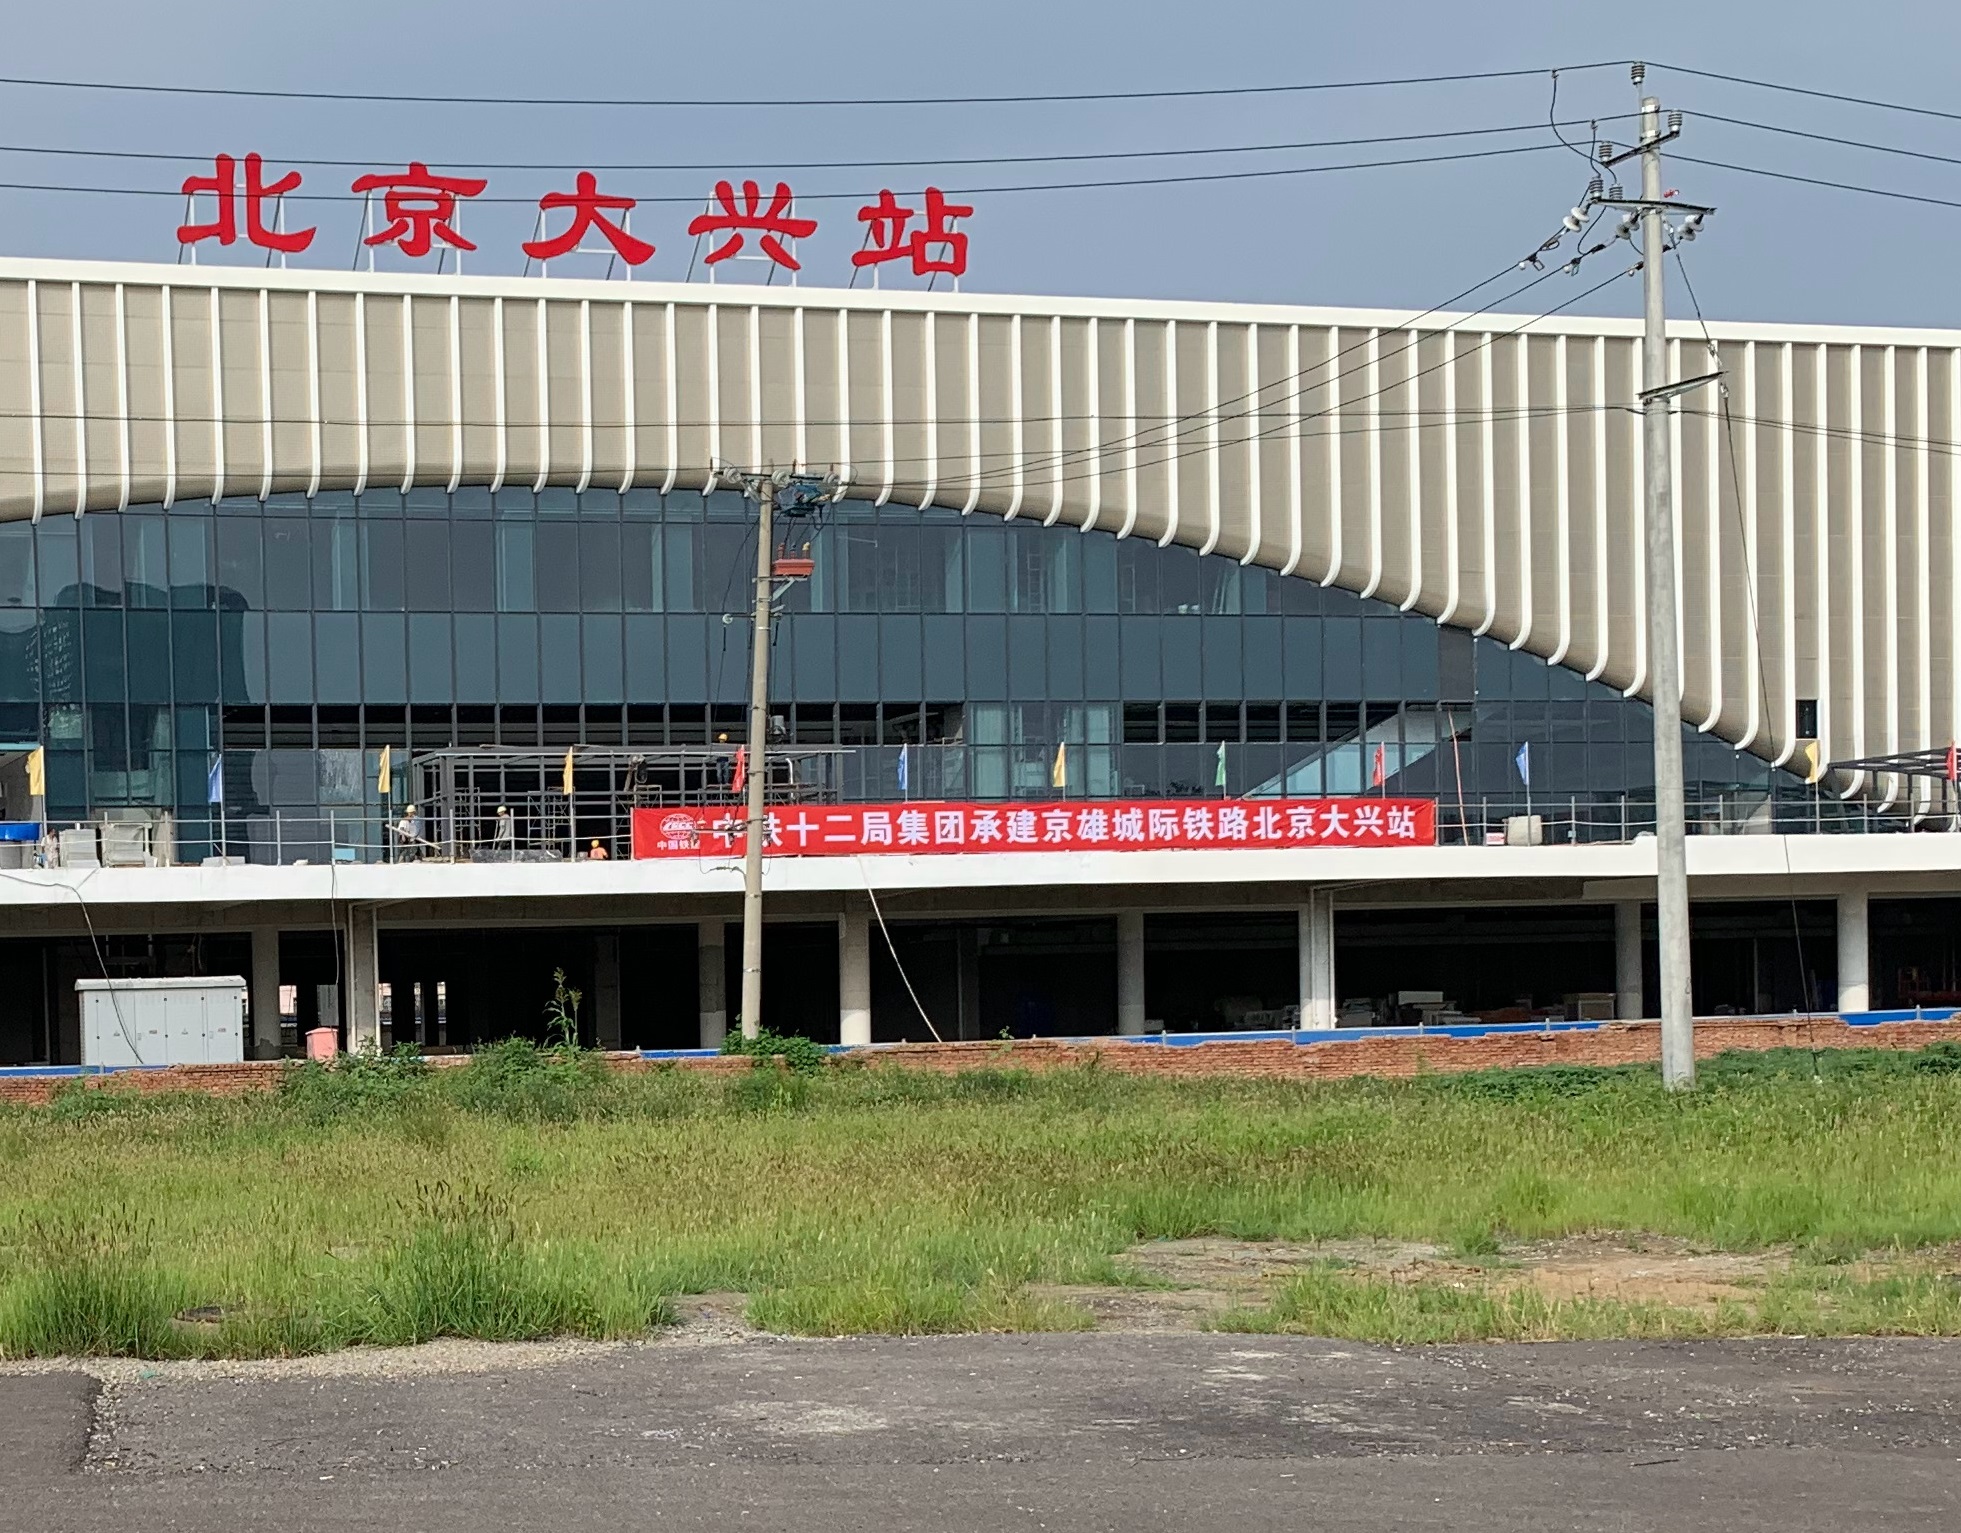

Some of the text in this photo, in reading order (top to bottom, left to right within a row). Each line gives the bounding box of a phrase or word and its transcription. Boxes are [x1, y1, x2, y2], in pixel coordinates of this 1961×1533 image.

[177, 153, 973, 275] 北京大兴站
